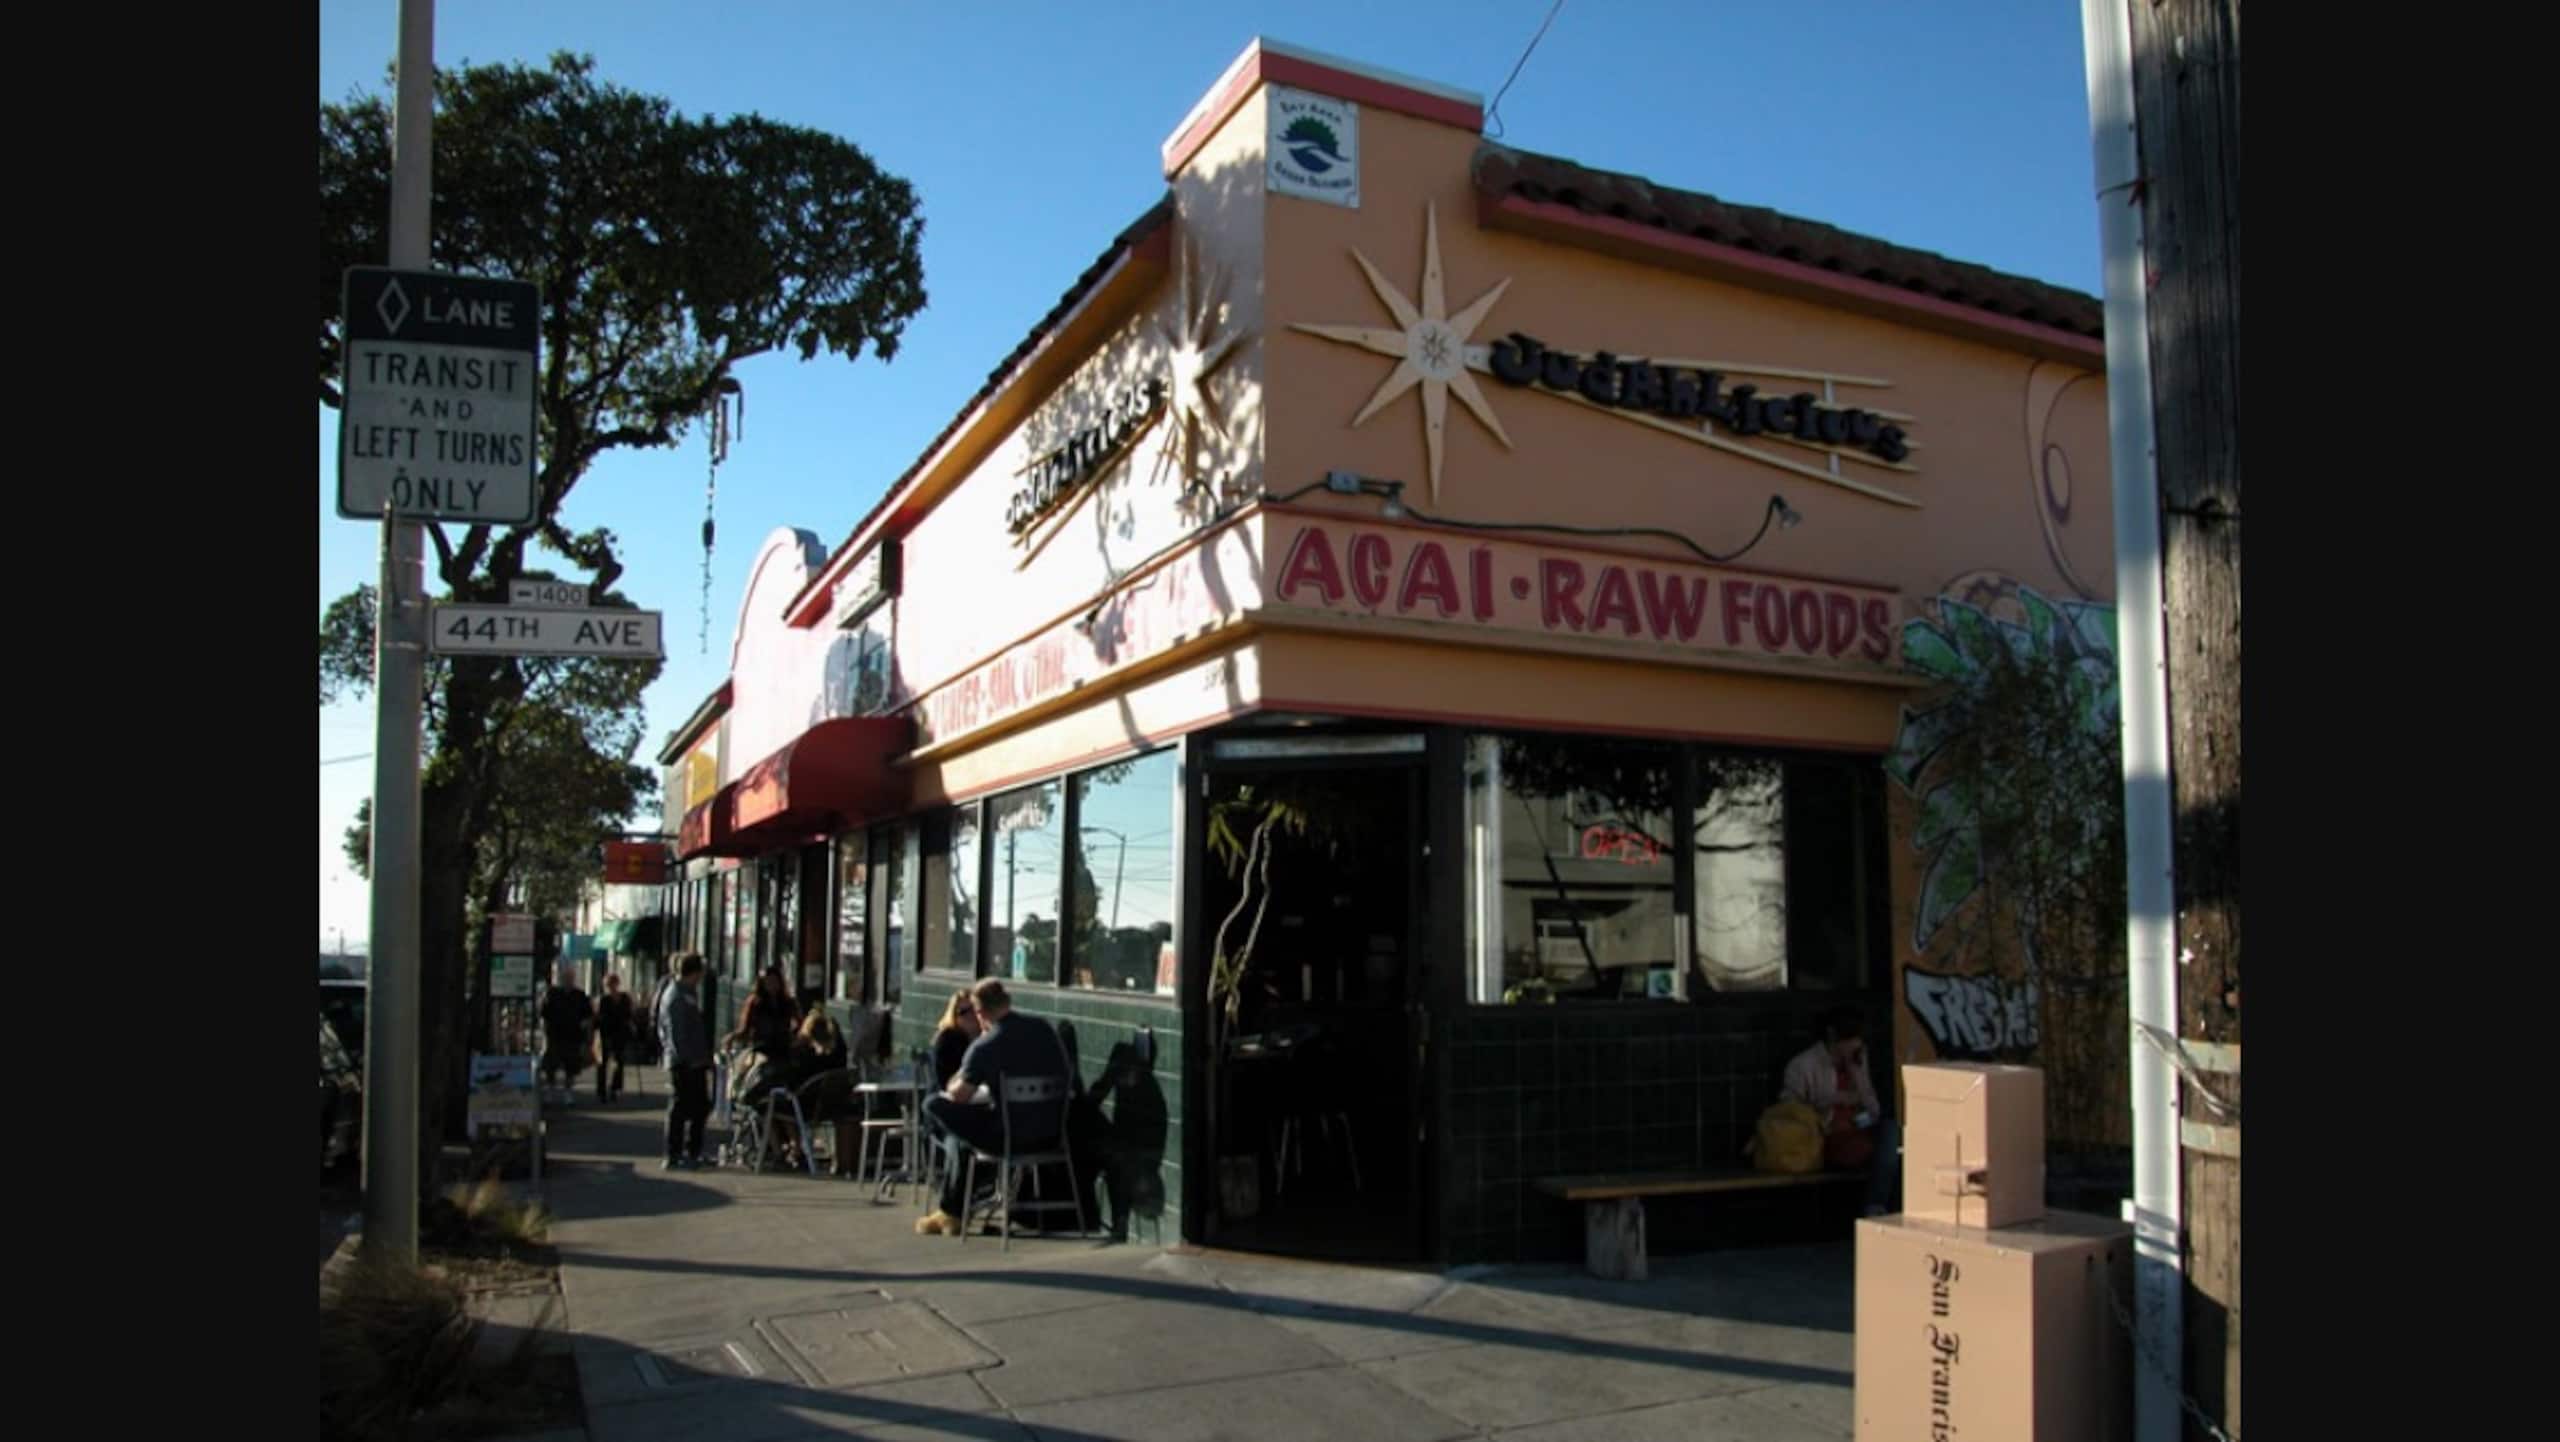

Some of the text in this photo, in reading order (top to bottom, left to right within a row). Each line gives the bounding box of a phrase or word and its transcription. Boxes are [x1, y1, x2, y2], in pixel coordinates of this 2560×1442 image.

[424, 297, 516, 329] LANE
[363, 351, 520, 393] TRANSIT
[409, 400, 473, 422] AND
[352, 425, 525, 467] LEFT TURNS
[391, 476, 487, 513] ONLY
[536, 585, 583, 602] 1400
[1540, 557, 1708, 643] RAW
[1720, 579, 1894, 665] FOODS
[446, 615, 643, 647] 44TH AVE
[1582, 825, 1660, 866] OPEN
[1923, 1252, 1961, 1318] San
